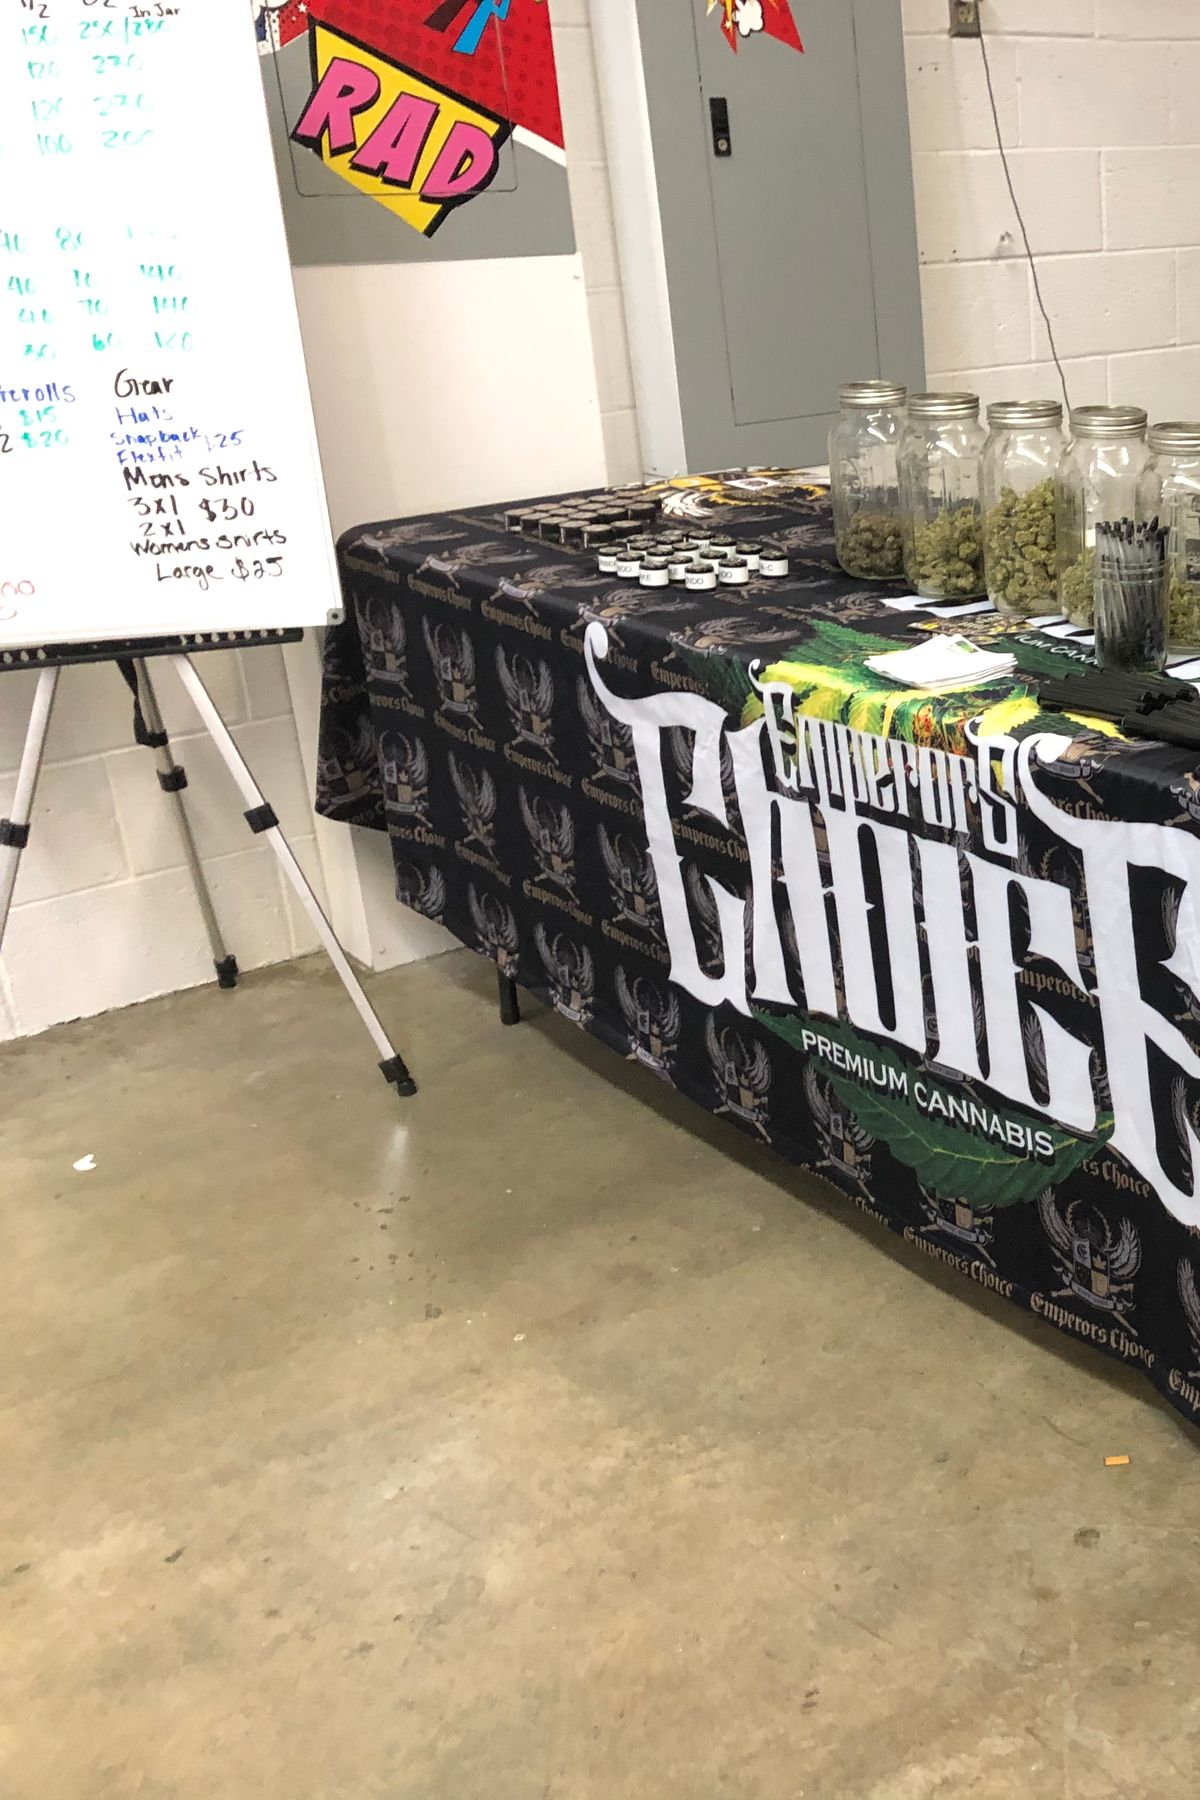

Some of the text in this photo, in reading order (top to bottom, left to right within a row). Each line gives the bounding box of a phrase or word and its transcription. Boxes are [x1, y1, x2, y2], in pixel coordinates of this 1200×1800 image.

[291, 56, 500, 204] RAD
[801, 1028, 1056, 1156] PREMIUM CANNABIS
